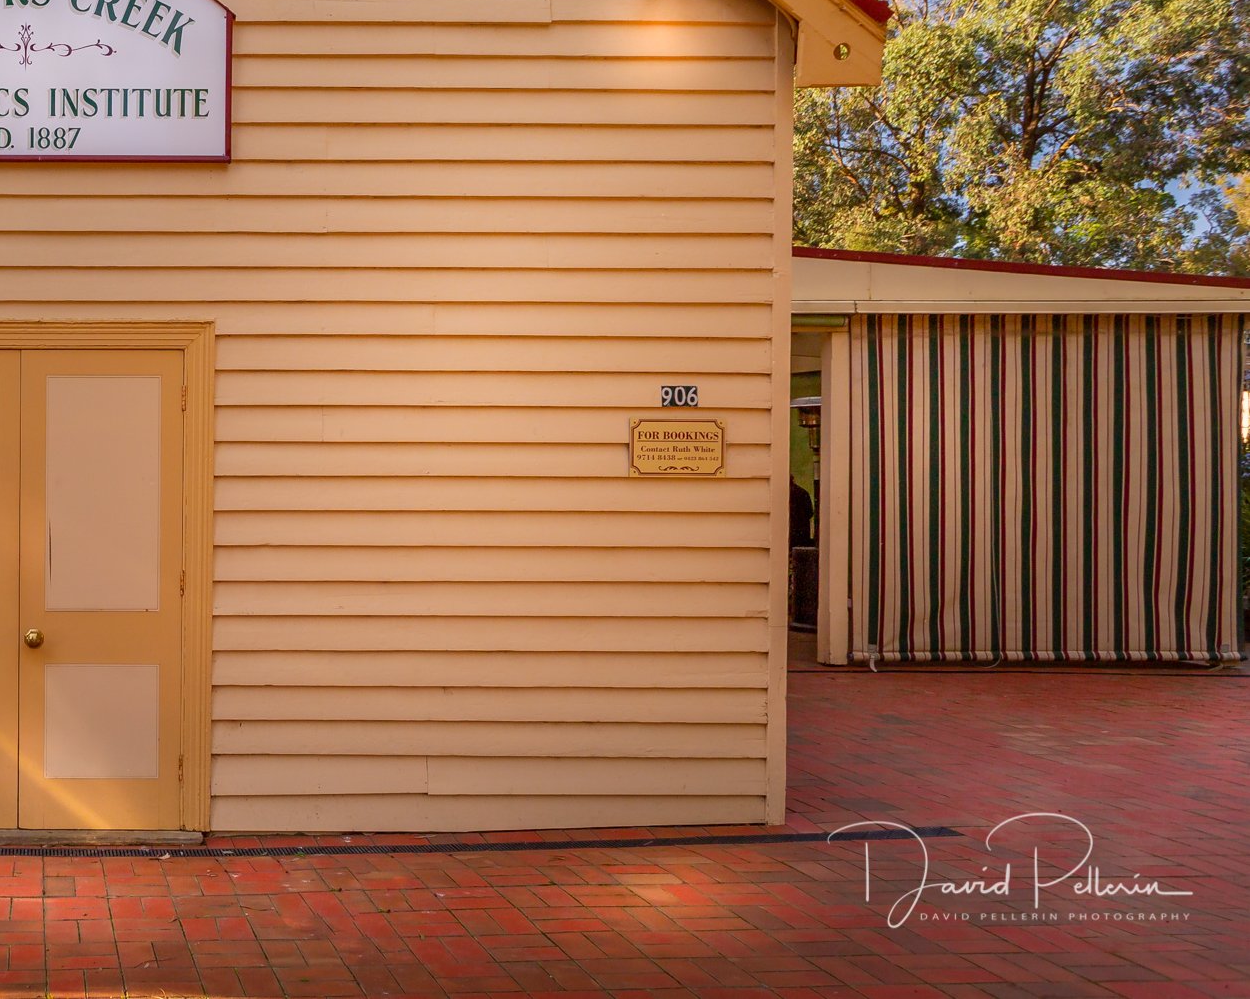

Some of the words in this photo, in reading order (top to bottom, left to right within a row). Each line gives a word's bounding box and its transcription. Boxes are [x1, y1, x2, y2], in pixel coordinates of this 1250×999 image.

[48, 87, 210, 118] INSTITUTE
[28, 127, 81, 150] 1887
[661, 386, 698, 406] 906
[638, 431, 659, 440] FOR
[663, 431, 719, 440] BOOKINGS
